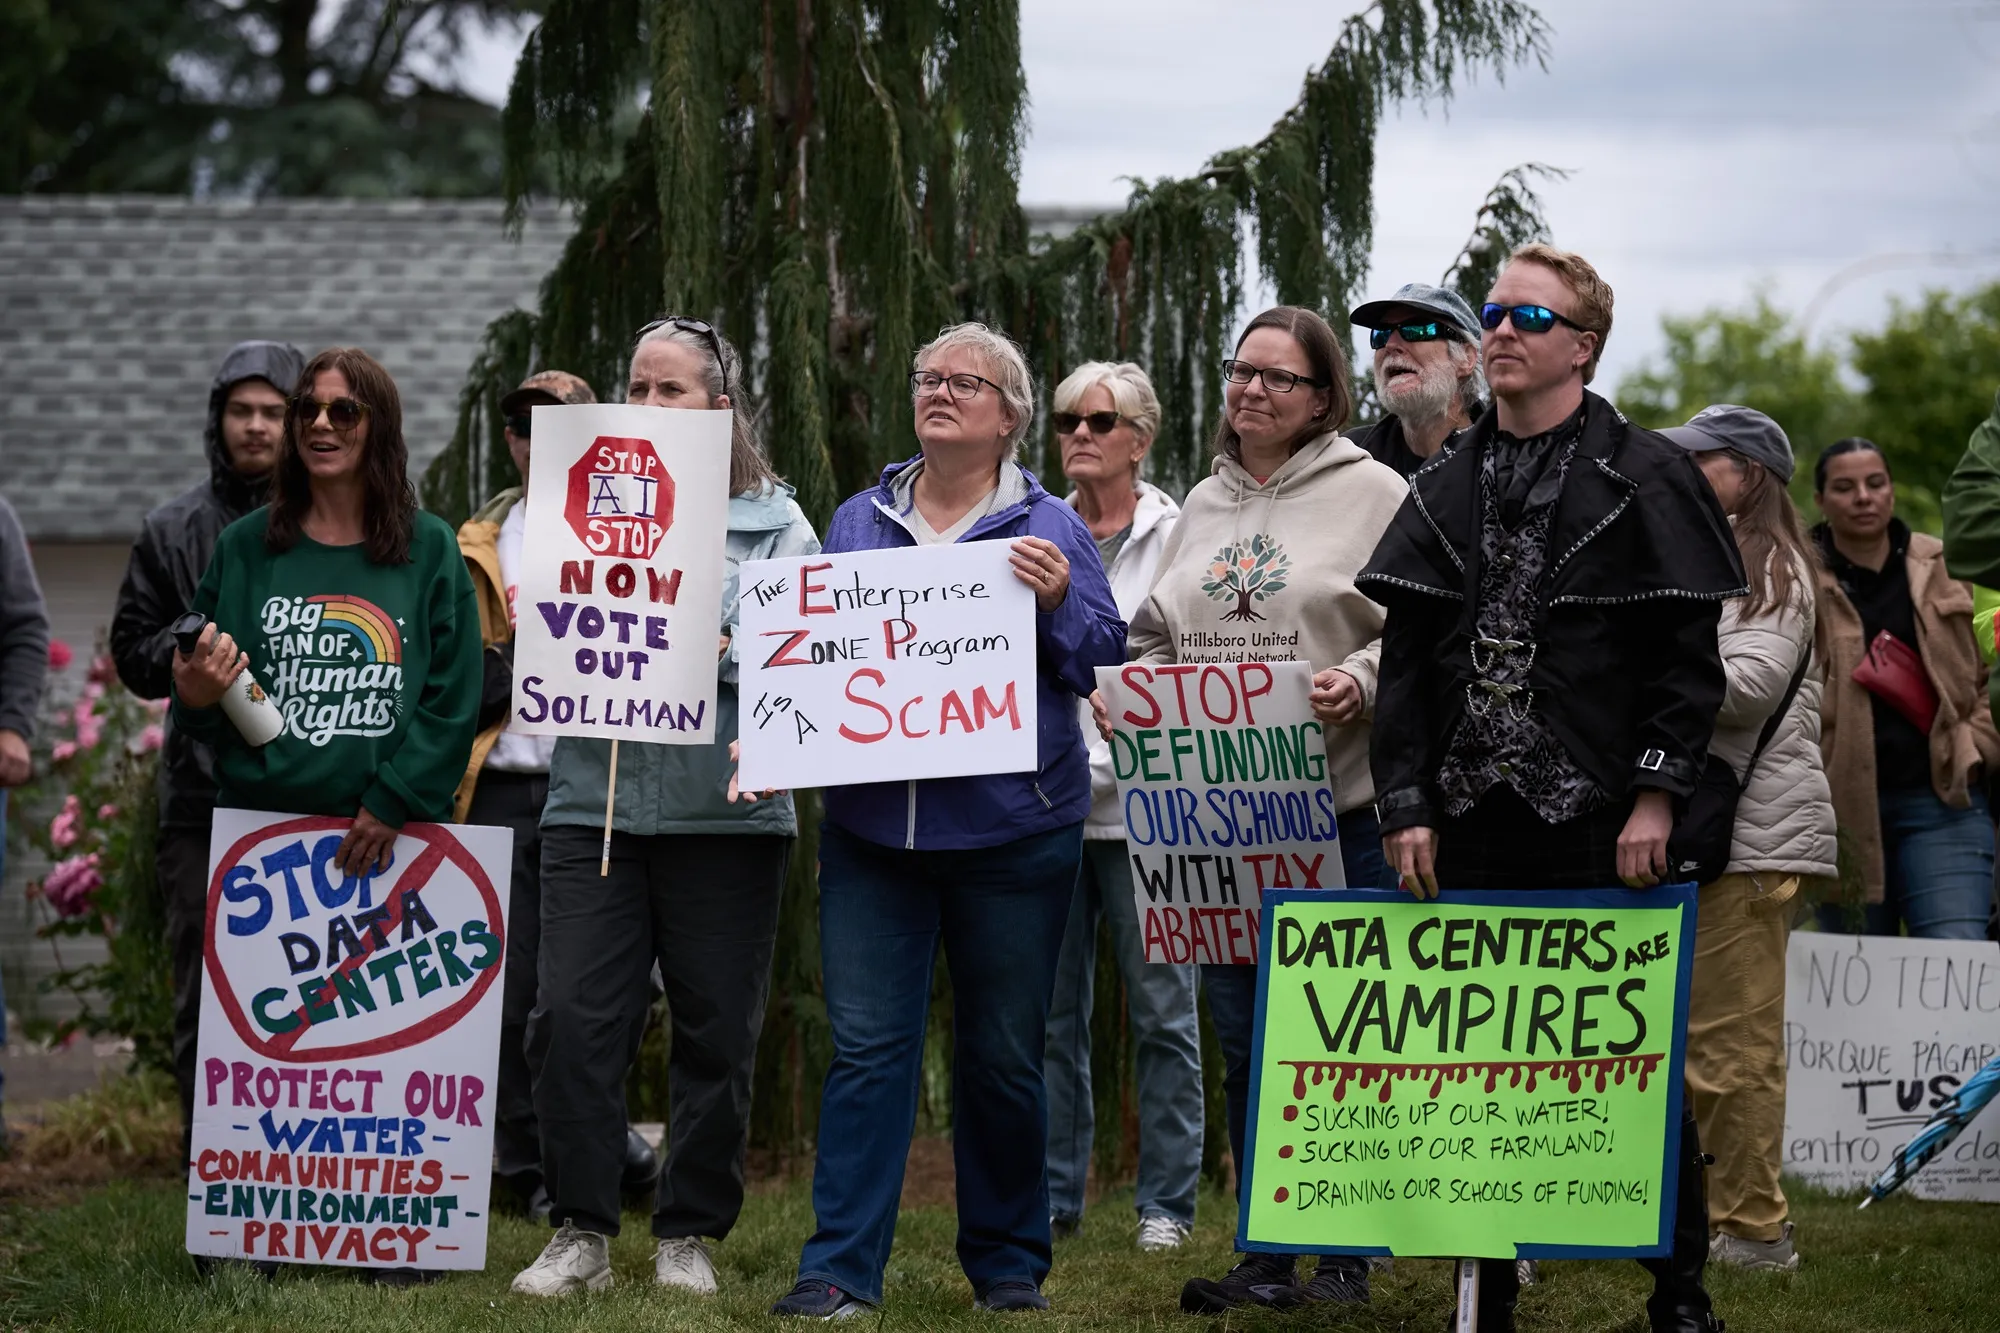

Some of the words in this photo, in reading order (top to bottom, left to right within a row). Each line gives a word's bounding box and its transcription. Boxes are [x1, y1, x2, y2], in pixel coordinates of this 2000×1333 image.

[594, 446, 657, 475] STOP
[586, 520, 662, 556] STOP
[560, 559, 683, 606] NOW
[741, 577, 789, 607] THE
[799, 562, 991, 620] Enterprise
[261, 596, 323, 634] Big
[536, 601, 670, 650] VOTE
[1181, 632, 1246, 647] Hillsboro
[1252, 630, 1298, 647] United
[269, 634, 313, 659] FAN
[319, 633, 351, 656] OF
[575, 648, 649, 681] OUT
[759, 629, 869, 670] ZONE
[882, 618, 1010, 665] Program
[1181, 652, 1222, 664] Mutual
[1225, 651, 1244, 663] Aid
[1248, 650, 1297, 663] Network
[270, 658, 404, 707] Human
[517, 676, 705, 731] SOLLMAN
[795, 709, 818, 744] A
[838, 668, 1022, 744] SCAM
[1121, 663, 1273, 728] STOP
[281, 691, 396, 747] Rights
[1110, 721, 1326, 784] DEFUNDING
[1125, 787, 1208, 848] OUR
[1206, 787, 1337, 848] SCHOOLS
[1132, 854, 1240, 905] WITH
[1242, 853, 1325, 904] TAX
[278, 888, 438, 975] DATA
[1277, 917, 1391, 971] DATA
[1407, 917, 1617, 972] CENTERS
[1624, 931, 1670, 971] ARE
[251, 920, 501, 1034] CENTERS
[1807, 951, 1871, 1008] NO
[1889, 956, 2000, 1012] TENE
[1303, 978, 1646, 1058] VAMPIRES
[1784, 1021, 1892, 1075] PORQUE
[204, 1058, 383, 1113] PROTECT
[405, 1071, 485, 1127] OUR
[1303, 1104, 1399, 1132] SUCKING
[1408, 1101, 1439, 1126] UP
[1449, 1102, 1507, 1126] OUR
[1515, 1099, 1610, 1127] WATER!
[1842, 1075, 1961, 1115] TUS
[1299, 1139, 1390, 1164] SUCKING
[1398, 1137, 1424, 1160] UP
[1429, 1136, 1477, 1160] OUR
[1490, 1129, 1614, 1160] FARMLAND!
[1297, 1178, 1395, 1210] DRAINING
[1403, 1178, 1442, 1200] OUR
[1449, 1179, 1523, 1204] SCHOOLS
[1534, 1179, 1557, 1203] OF
[1567, 1179, 1648, 1206] FUNDING!
